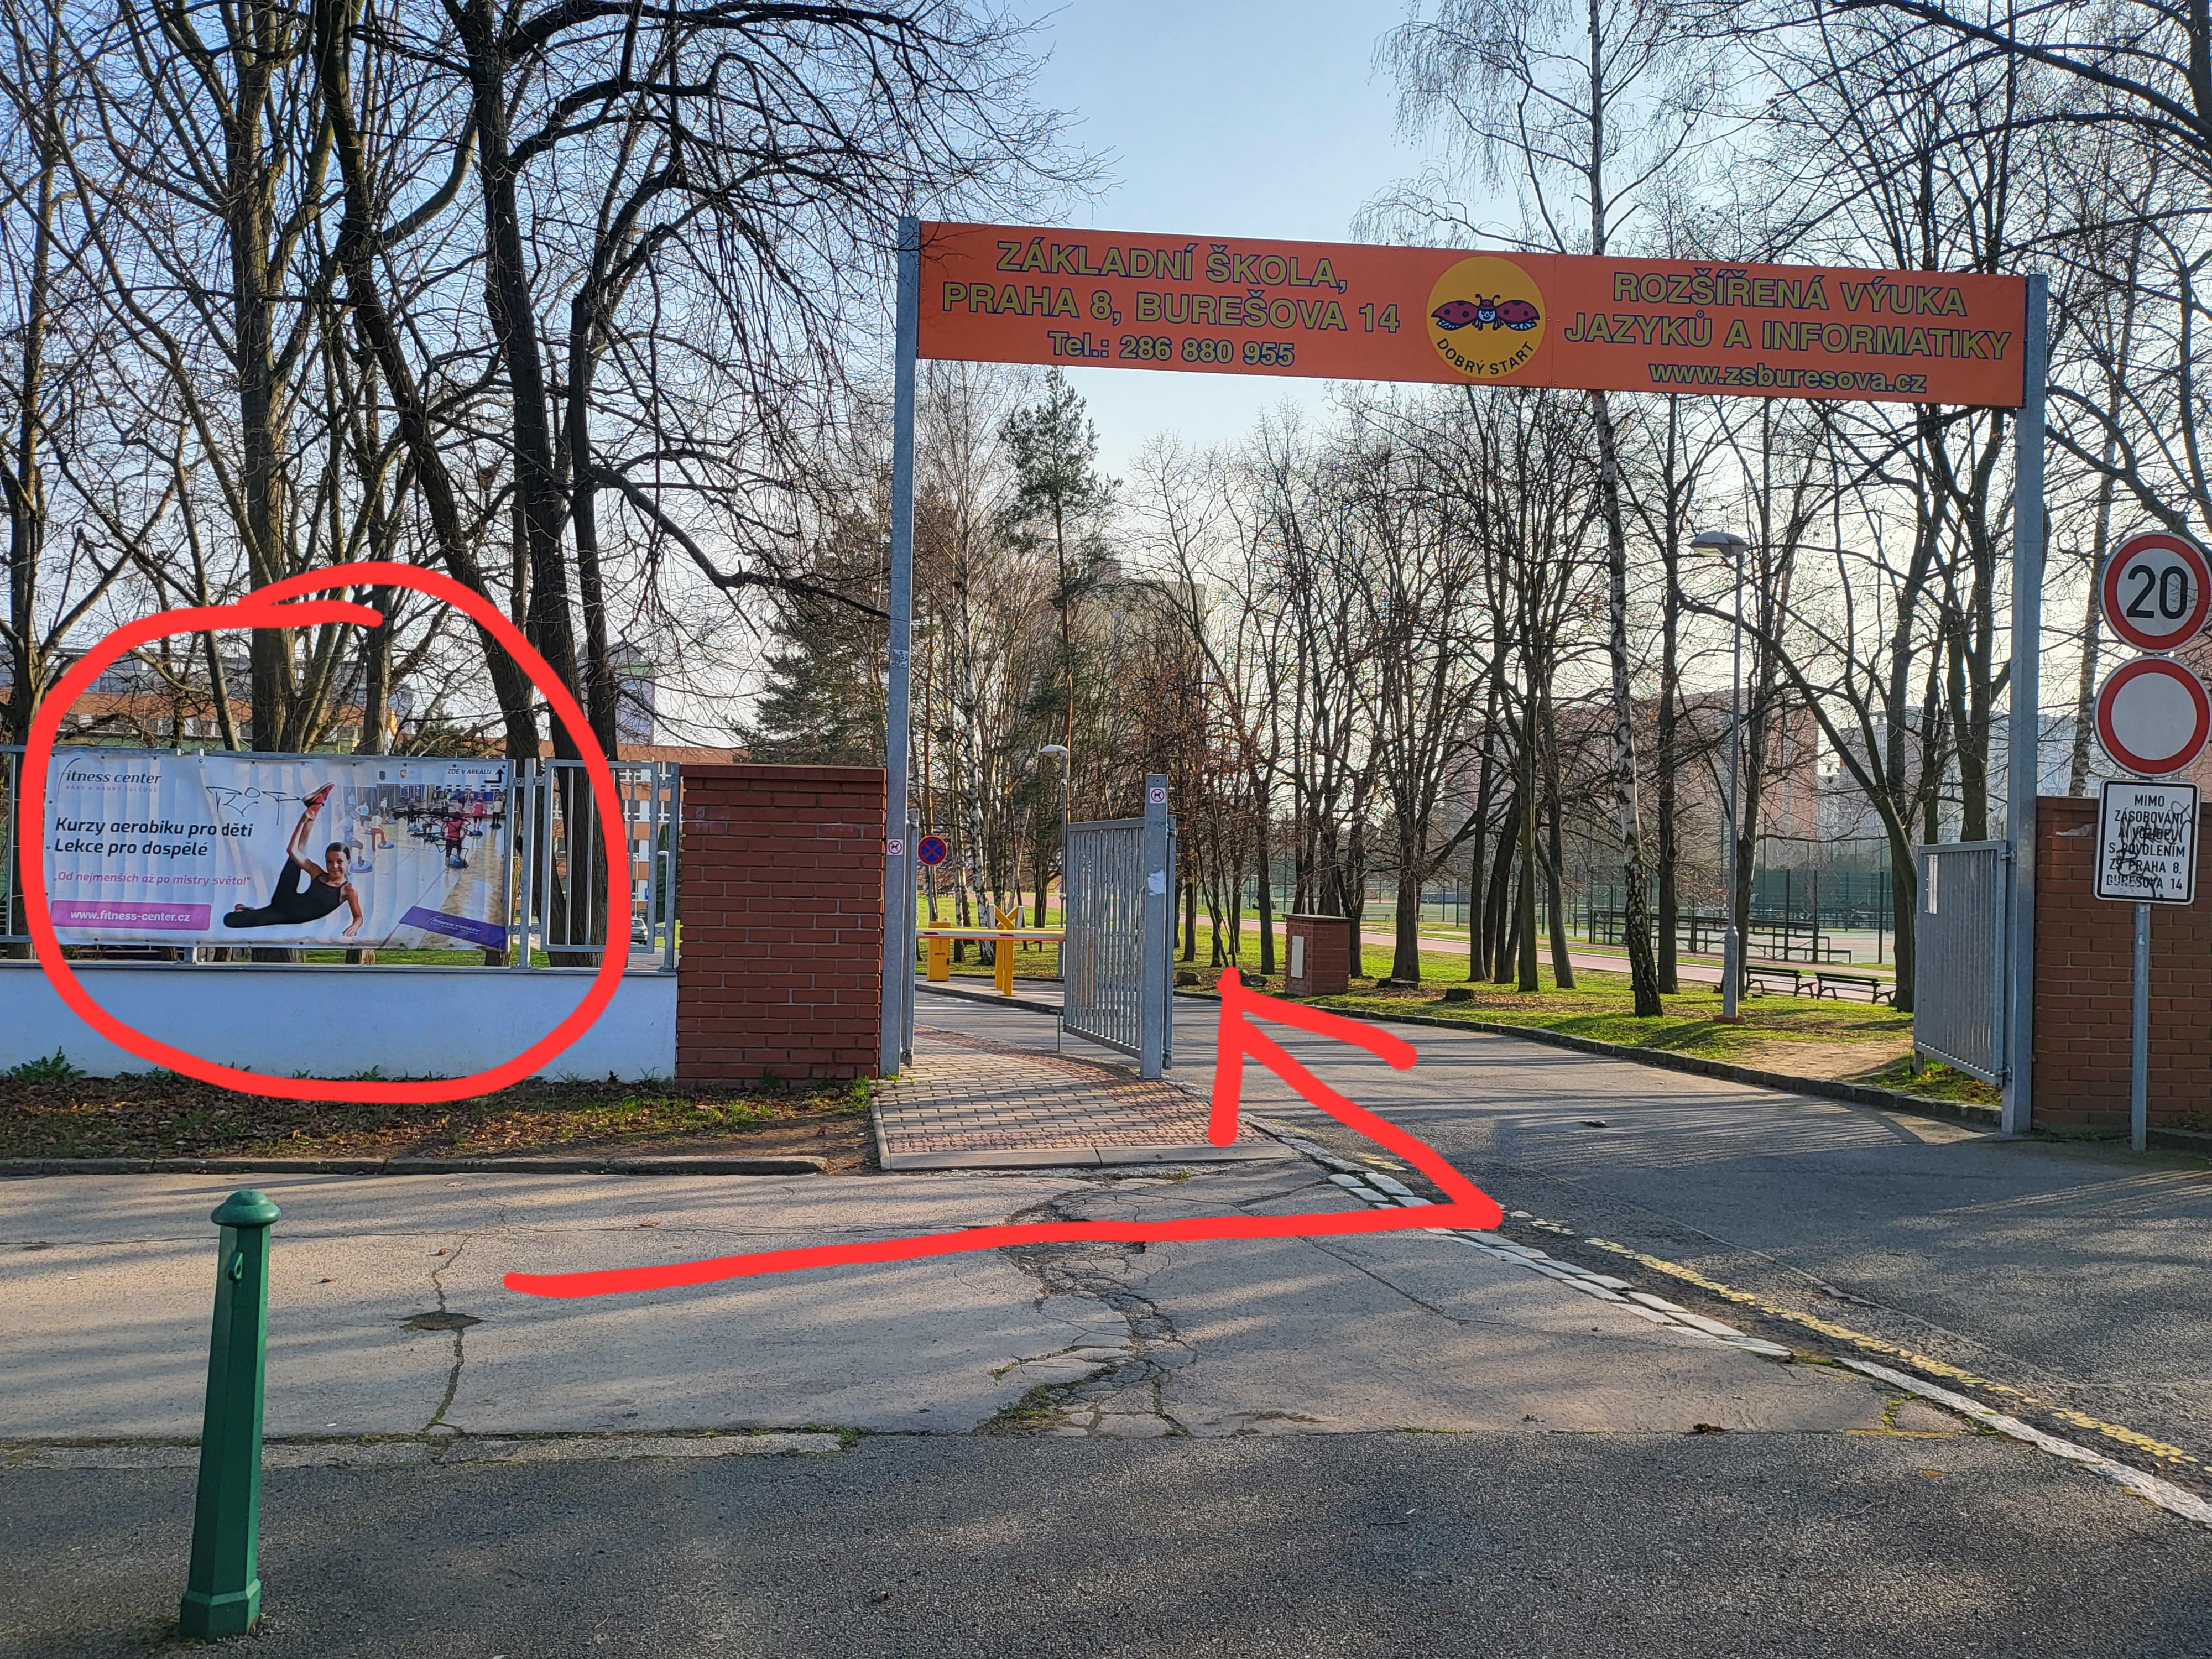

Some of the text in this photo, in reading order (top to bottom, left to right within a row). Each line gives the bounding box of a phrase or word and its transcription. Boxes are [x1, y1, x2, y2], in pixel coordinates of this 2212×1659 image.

[996, 237, 1347, 294] ZÁKLADNÍ ŠKOLA,
[1613, 267, 1968, 317] ROZŠÍŘENÁ VÝUKA
[943, 281, 1400, 333] PRAHA 8, BUREŠOVA 14
[1564, 310, 2012, 360] JAZYKŮ A INFORMATIKY
[1047, 331, 1295, 367] Tel.: 286 880 955
[1437, 338, 1533, 375] DOBRÝ START
[1648, 363, 1927, 393] www.zsburesova.cz
[2126, 565, 2188, 620] 20
[114, 773, 163, 784] center
[2134, 794, 2165, 807] MIMO
[56, 817, 253, 838] Kurzy aerobiku pro děti
[55, 838, 208, 859] Lekce pro dospělé
[2109, 842, 2185, 857] S POVOLENÍM
[2128, 859, 2166, 873] PRAHA
[76, 872, 138, 884] nejmenších
[142, 873, 154, 883] až
[156, 876, 170, 885] po
[173, 874, 210, 886] mistry
[2170, 878, 2183, 890] 14
[71, 910, 190, 922] www.fitness-center.cz
